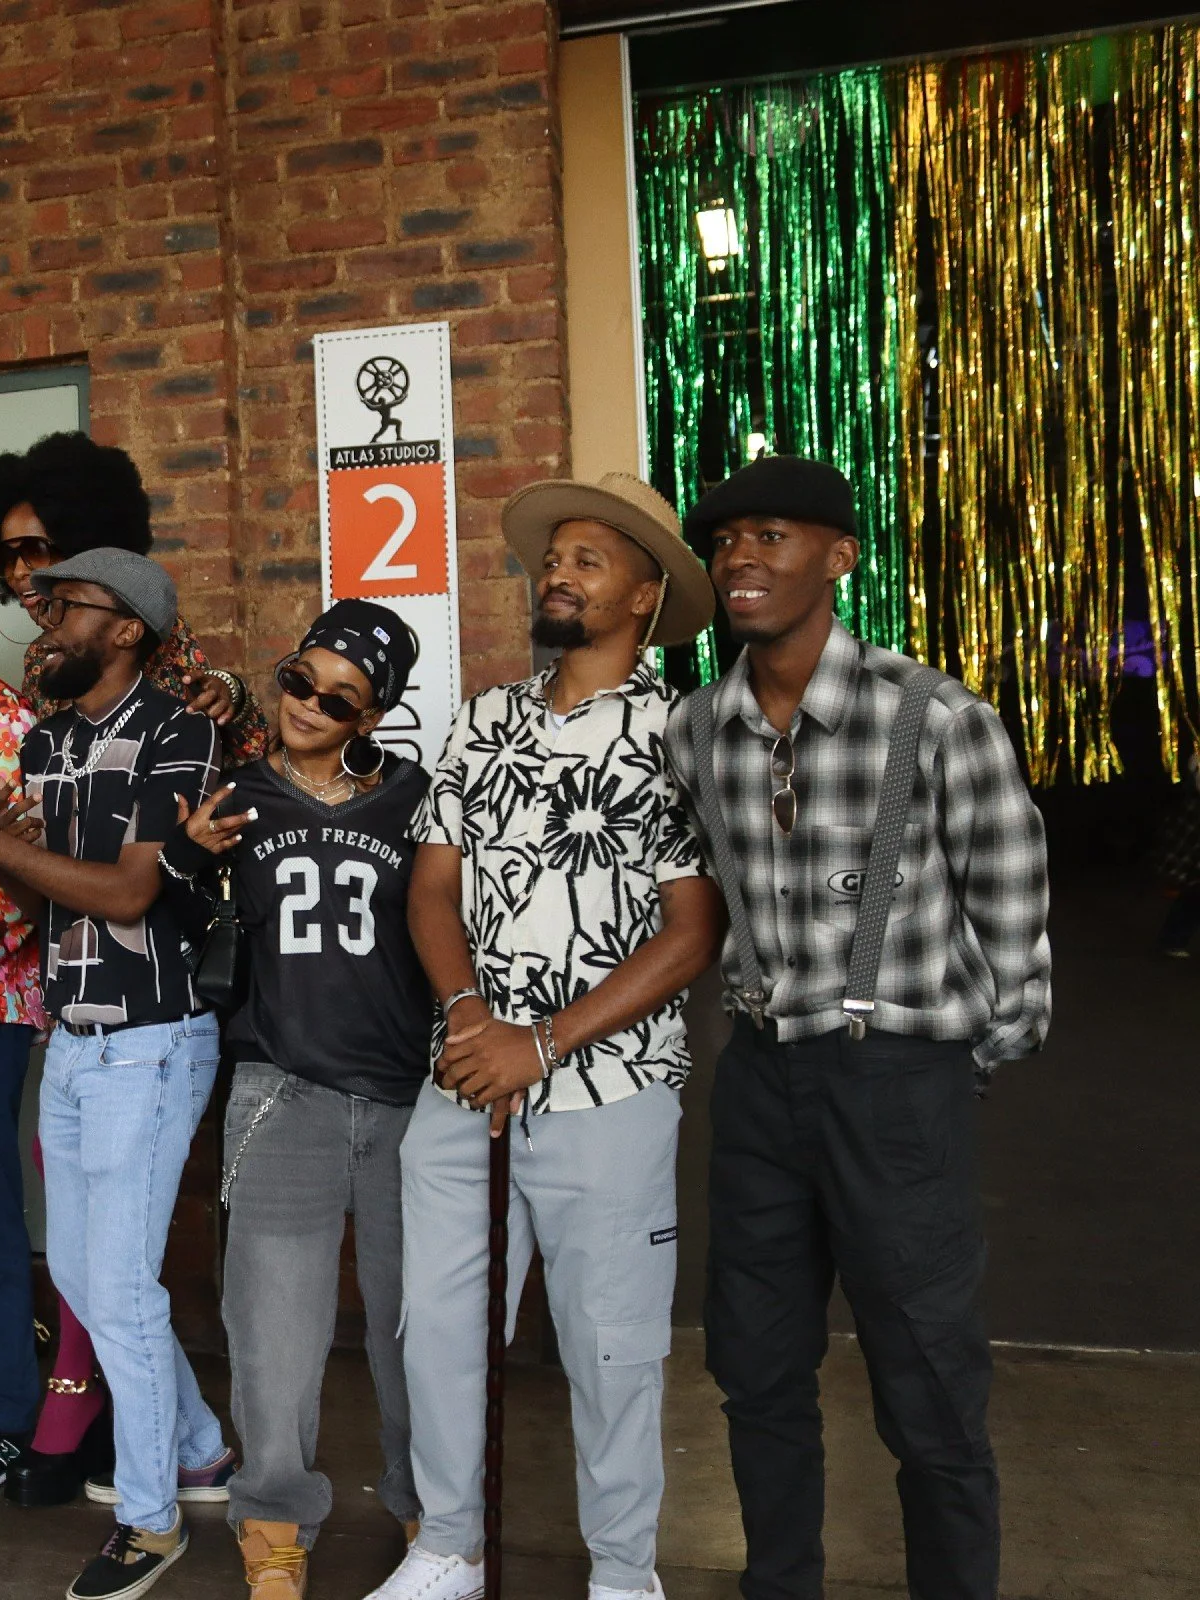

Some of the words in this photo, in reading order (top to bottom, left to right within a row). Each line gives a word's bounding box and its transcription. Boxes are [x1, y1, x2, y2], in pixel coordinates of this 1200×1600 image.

[335, 448, 375, 464] ATLAS
[379, 444, 436, 461] STUDIOS
[360, 483, 418, 581] 2
[253, 829, 309, 861] ENJOY
[321, 827, 403, 870] FREEDOM
[275, 856, 379, 956] 23
